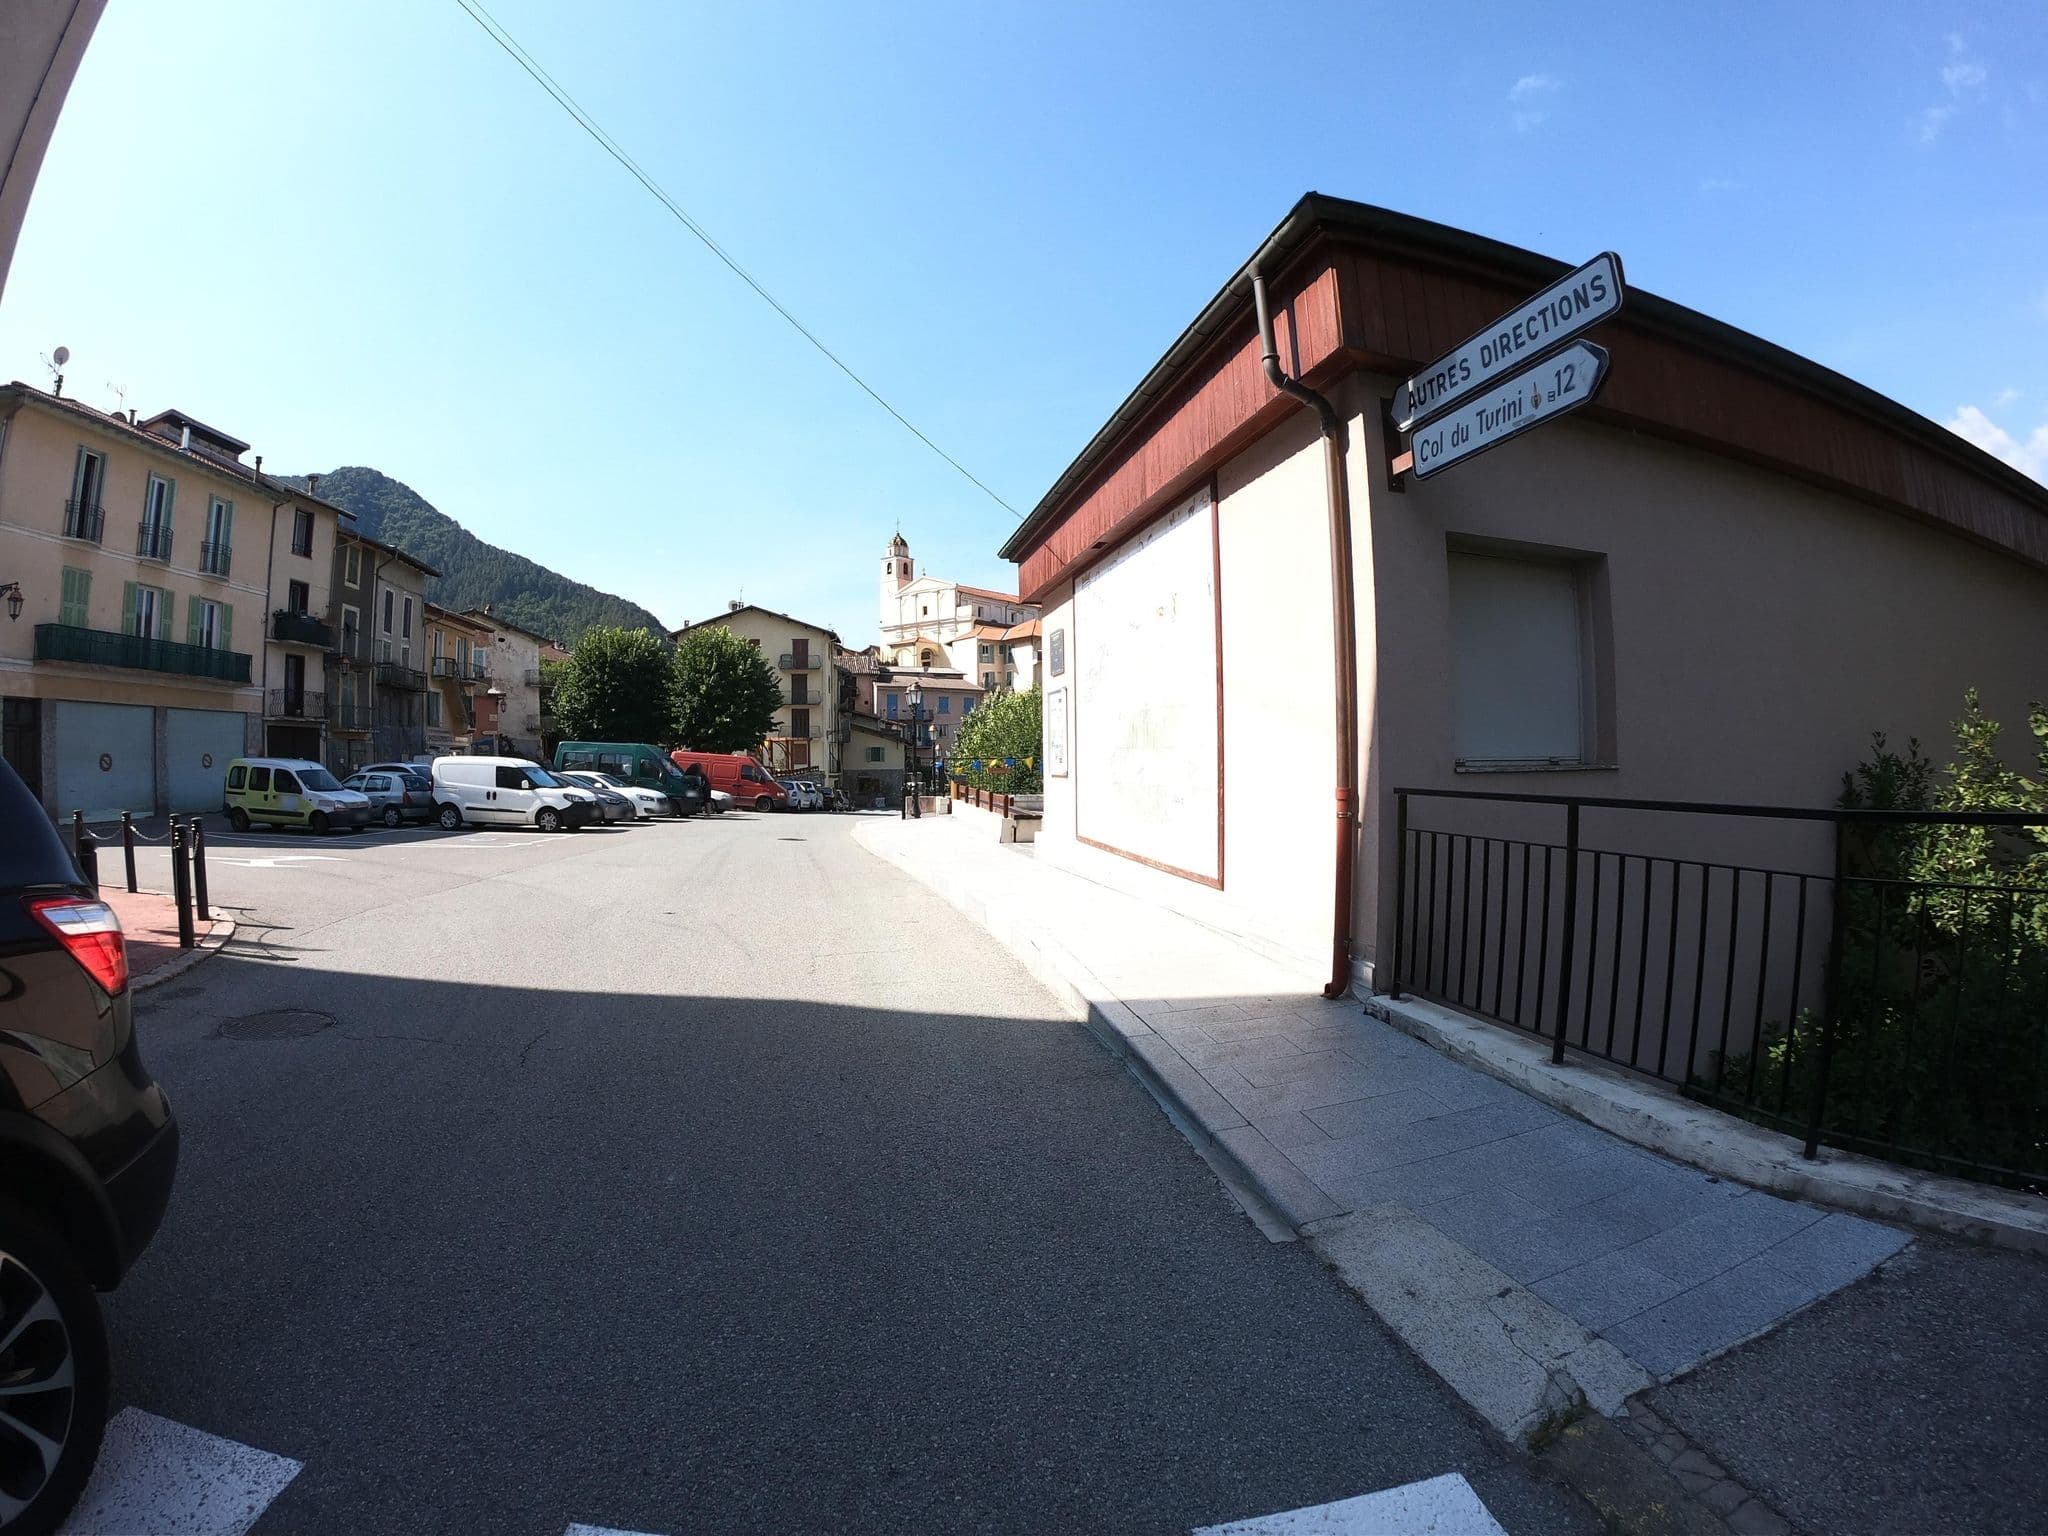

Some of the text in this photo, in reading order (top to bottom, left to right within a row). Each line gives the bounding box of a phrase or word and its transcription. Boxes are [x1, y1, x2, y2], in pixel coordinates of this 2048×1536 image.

[1408, 274, 1607, 413] AUTRES DIRECTIONS
[1420, 433, 1444, 463] Col
[1451, 422, 1469, 448] du
[1476, 390, 1523, 435] Turini
